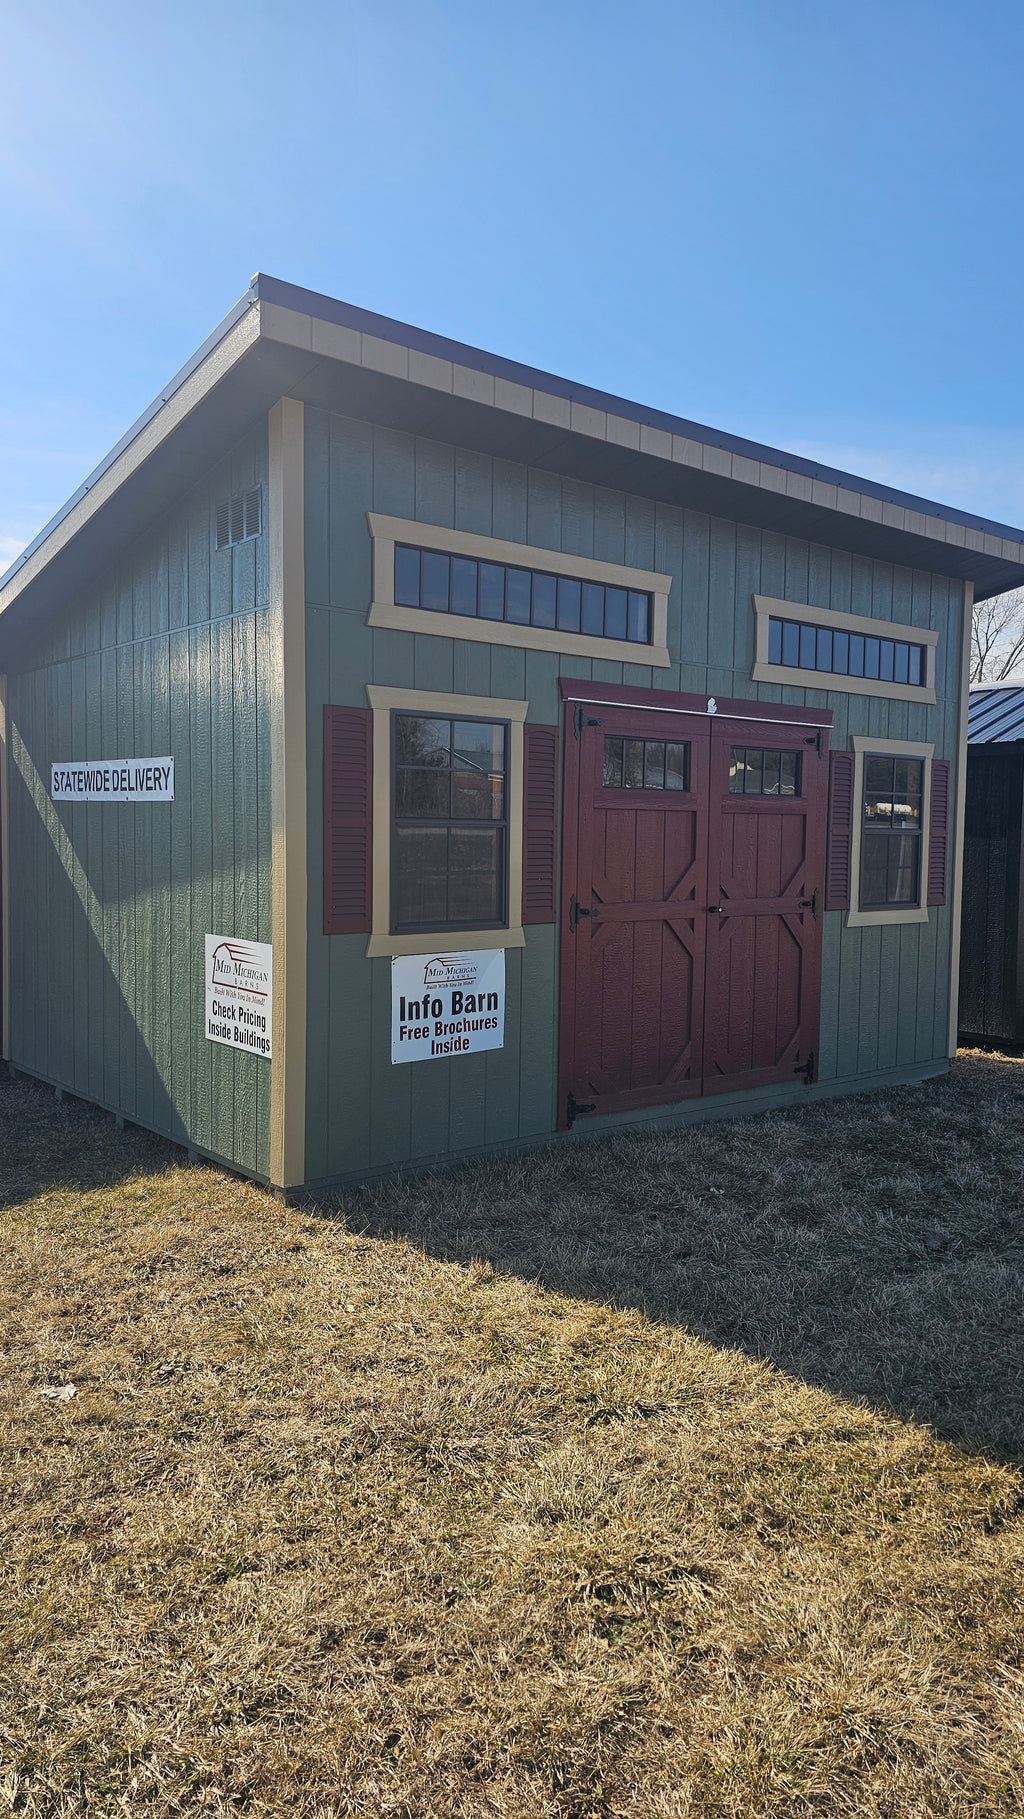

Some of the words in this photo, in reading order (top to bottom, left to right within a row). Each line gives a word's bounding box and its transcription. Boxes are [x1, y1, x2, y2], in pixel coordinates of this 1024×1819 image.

[54, 770, 109, 792] STATEWIDE
[113, 767, 170, 791] DELIVERY
[226, 989, 236, 998] With
[237, 991, 245, 1001] You
[246, 994, 251, 1002] In
[235, 978, 259, 990] BARNS
[212, 1000, 236, 1020] Check
[239, 1006, 266, 1032] Pricing
[400, 994, 442, 1021] Info
[452, 991, 498, 1015] Barn
[209, 1019, 231, 1040] Inside
[234, 1026, 270, 1053] Buildings
[400, 1025, 429, 1041] Free
[435, 1017, 497, 1036] Brochures
[431, 1036, 469, 1055] Inside
